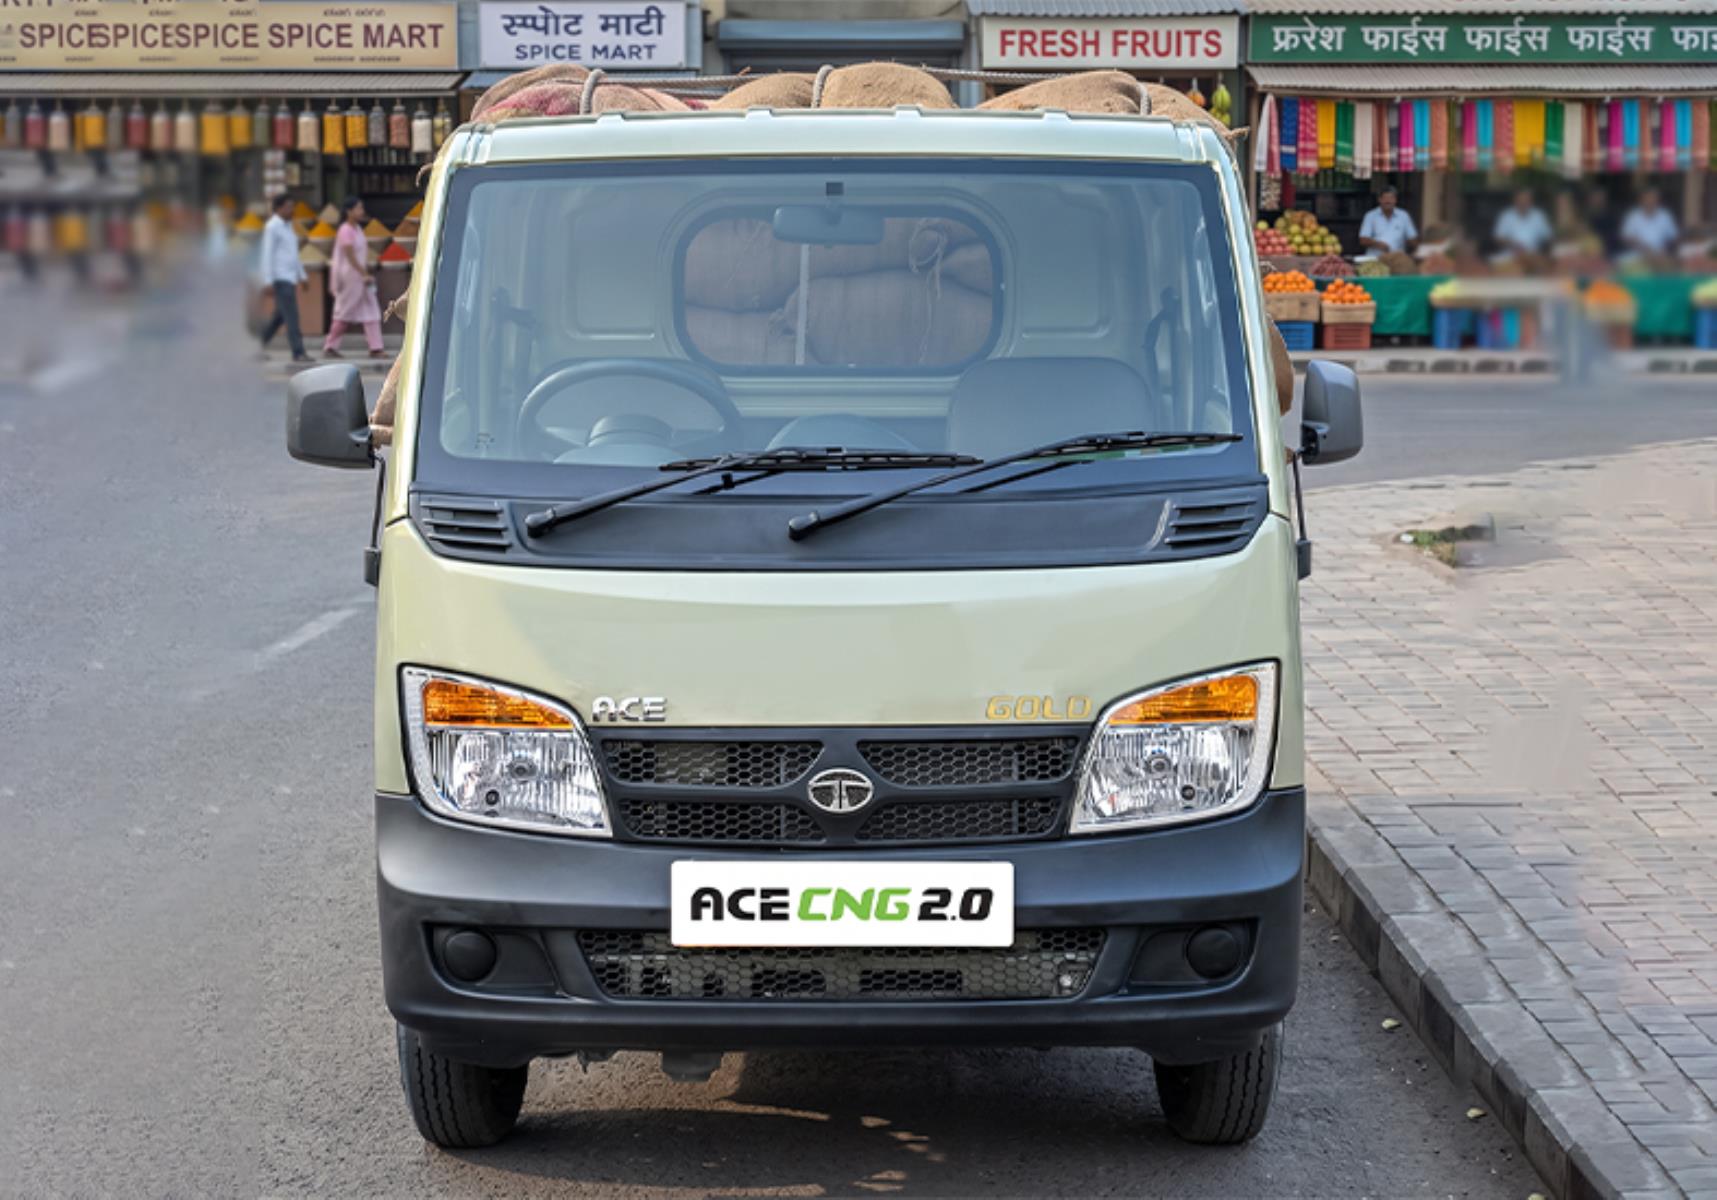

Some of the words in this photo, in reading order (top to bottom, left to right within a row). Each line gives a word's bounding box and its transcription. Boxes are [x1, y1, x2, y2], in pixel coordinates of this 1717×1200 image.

[598, 5, 666, 37] माटी
[268, 23, 354, 48] SPICE
[363, 23, 444, 48] MART
[1000, 29, 1100, 57] FRESH
[1112, 29, 1222, 57] FRUITS
[515, 44, 582, 60] SPICE
[591, 44, 657, 60] MART
[592, 696, 667, 722] ACE
[985, 695, 1092, 720] GOLD
[690, 887, 790, 921] ACE
[797, 887, 912, 921] CNG
[917, 887, 994, 921] 2.0
